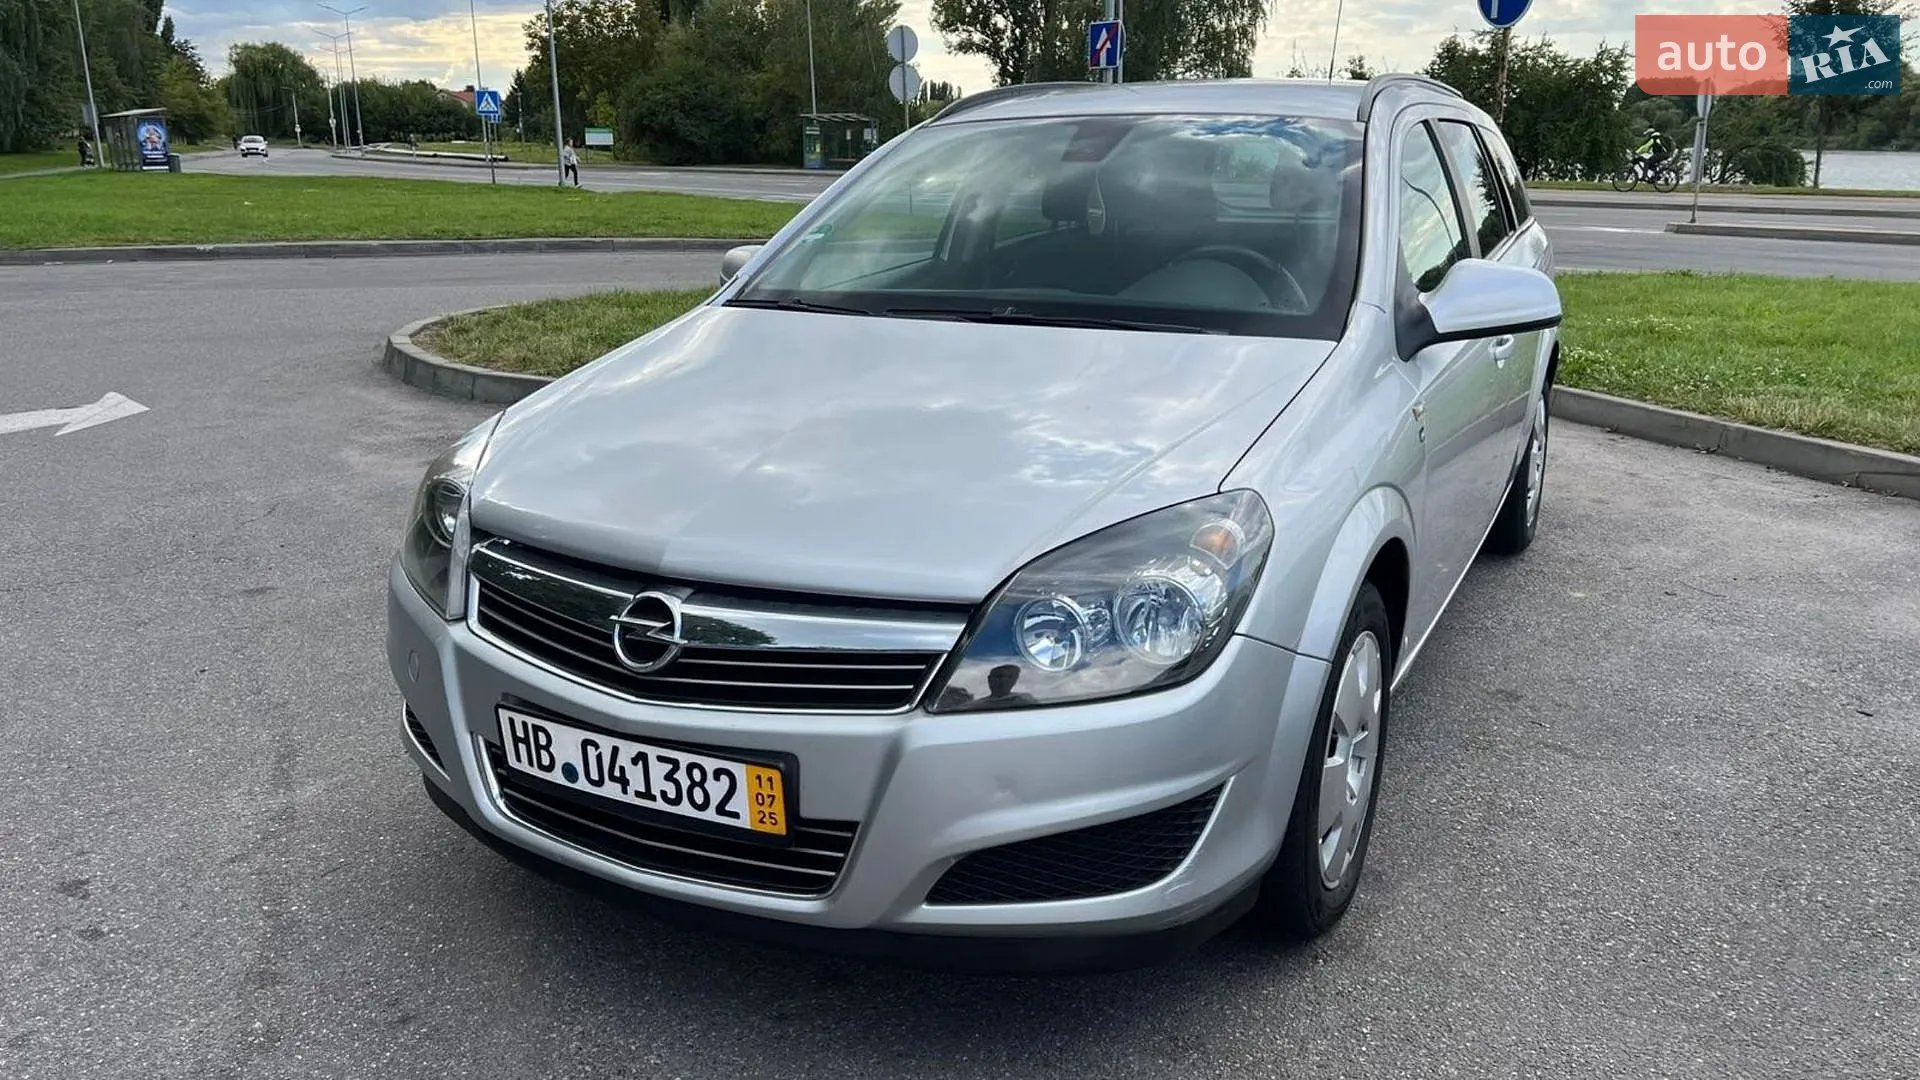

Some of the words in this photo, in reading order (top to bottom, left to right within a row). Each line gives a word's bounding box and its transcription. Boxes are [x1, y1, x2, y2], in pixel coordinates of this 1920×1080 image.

[508, 717, 556, 773] HB
[580, 738, 741, 820] 041382
[755, 774, 774, 791] 11
[755, 792, 776, 809] 07
[757, 810, 778, 826] 25
